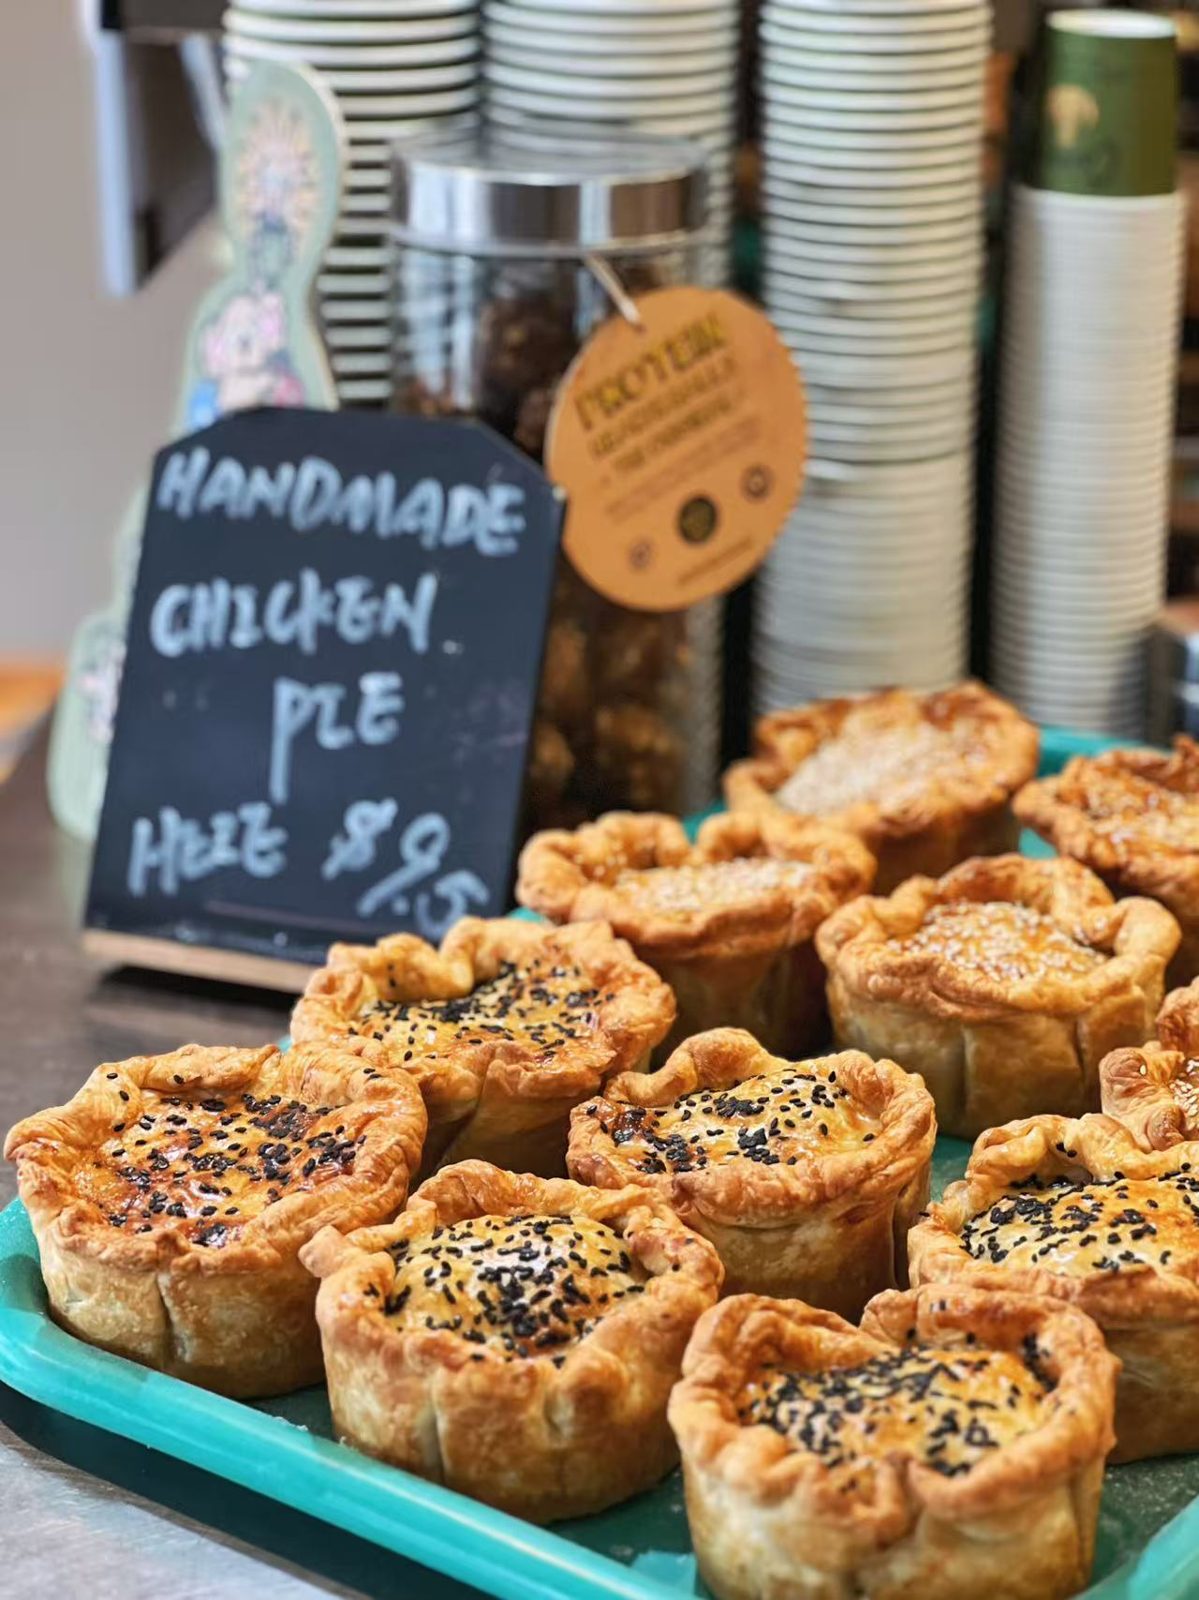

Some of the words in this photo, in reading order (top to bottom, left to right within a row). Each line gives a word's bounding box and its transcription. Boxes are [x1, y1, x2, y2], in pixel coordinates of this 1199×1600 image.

[157, 446, 526, 556] HANDMADE
[150, 568, 438, 657] CHICKEN
[270, 671, 405, 803] PIE
